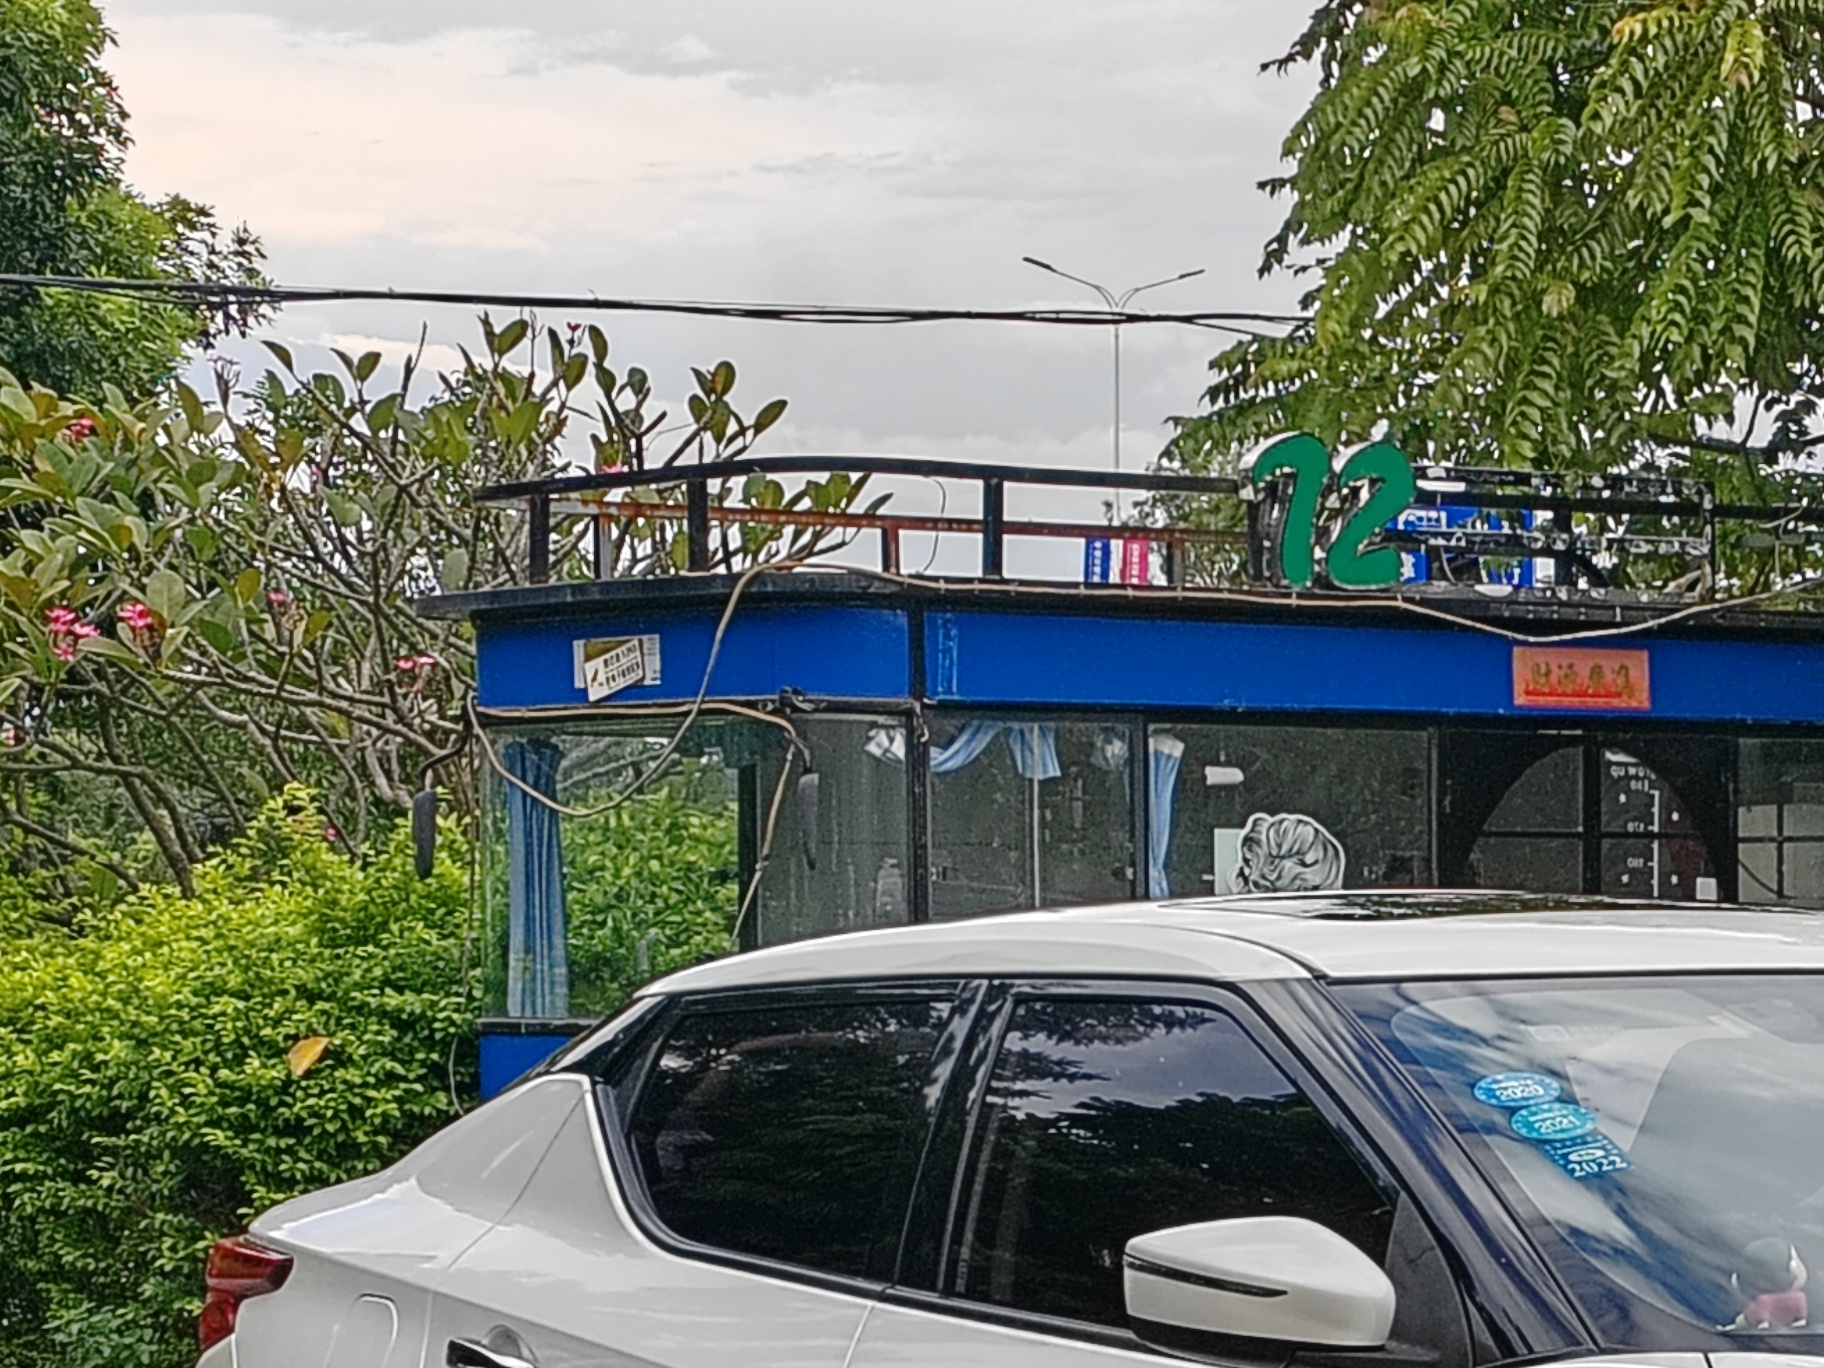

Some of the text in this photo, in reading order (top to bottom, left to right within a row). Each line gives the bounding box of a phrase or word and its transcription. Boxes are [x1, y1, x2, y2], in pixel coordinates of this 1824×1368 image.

[1495, 1085, 1544, 1101] 2020
[1534, 1115, 1580, 1134] 2021
[1567, 1155, 1627, 1177] 2022
